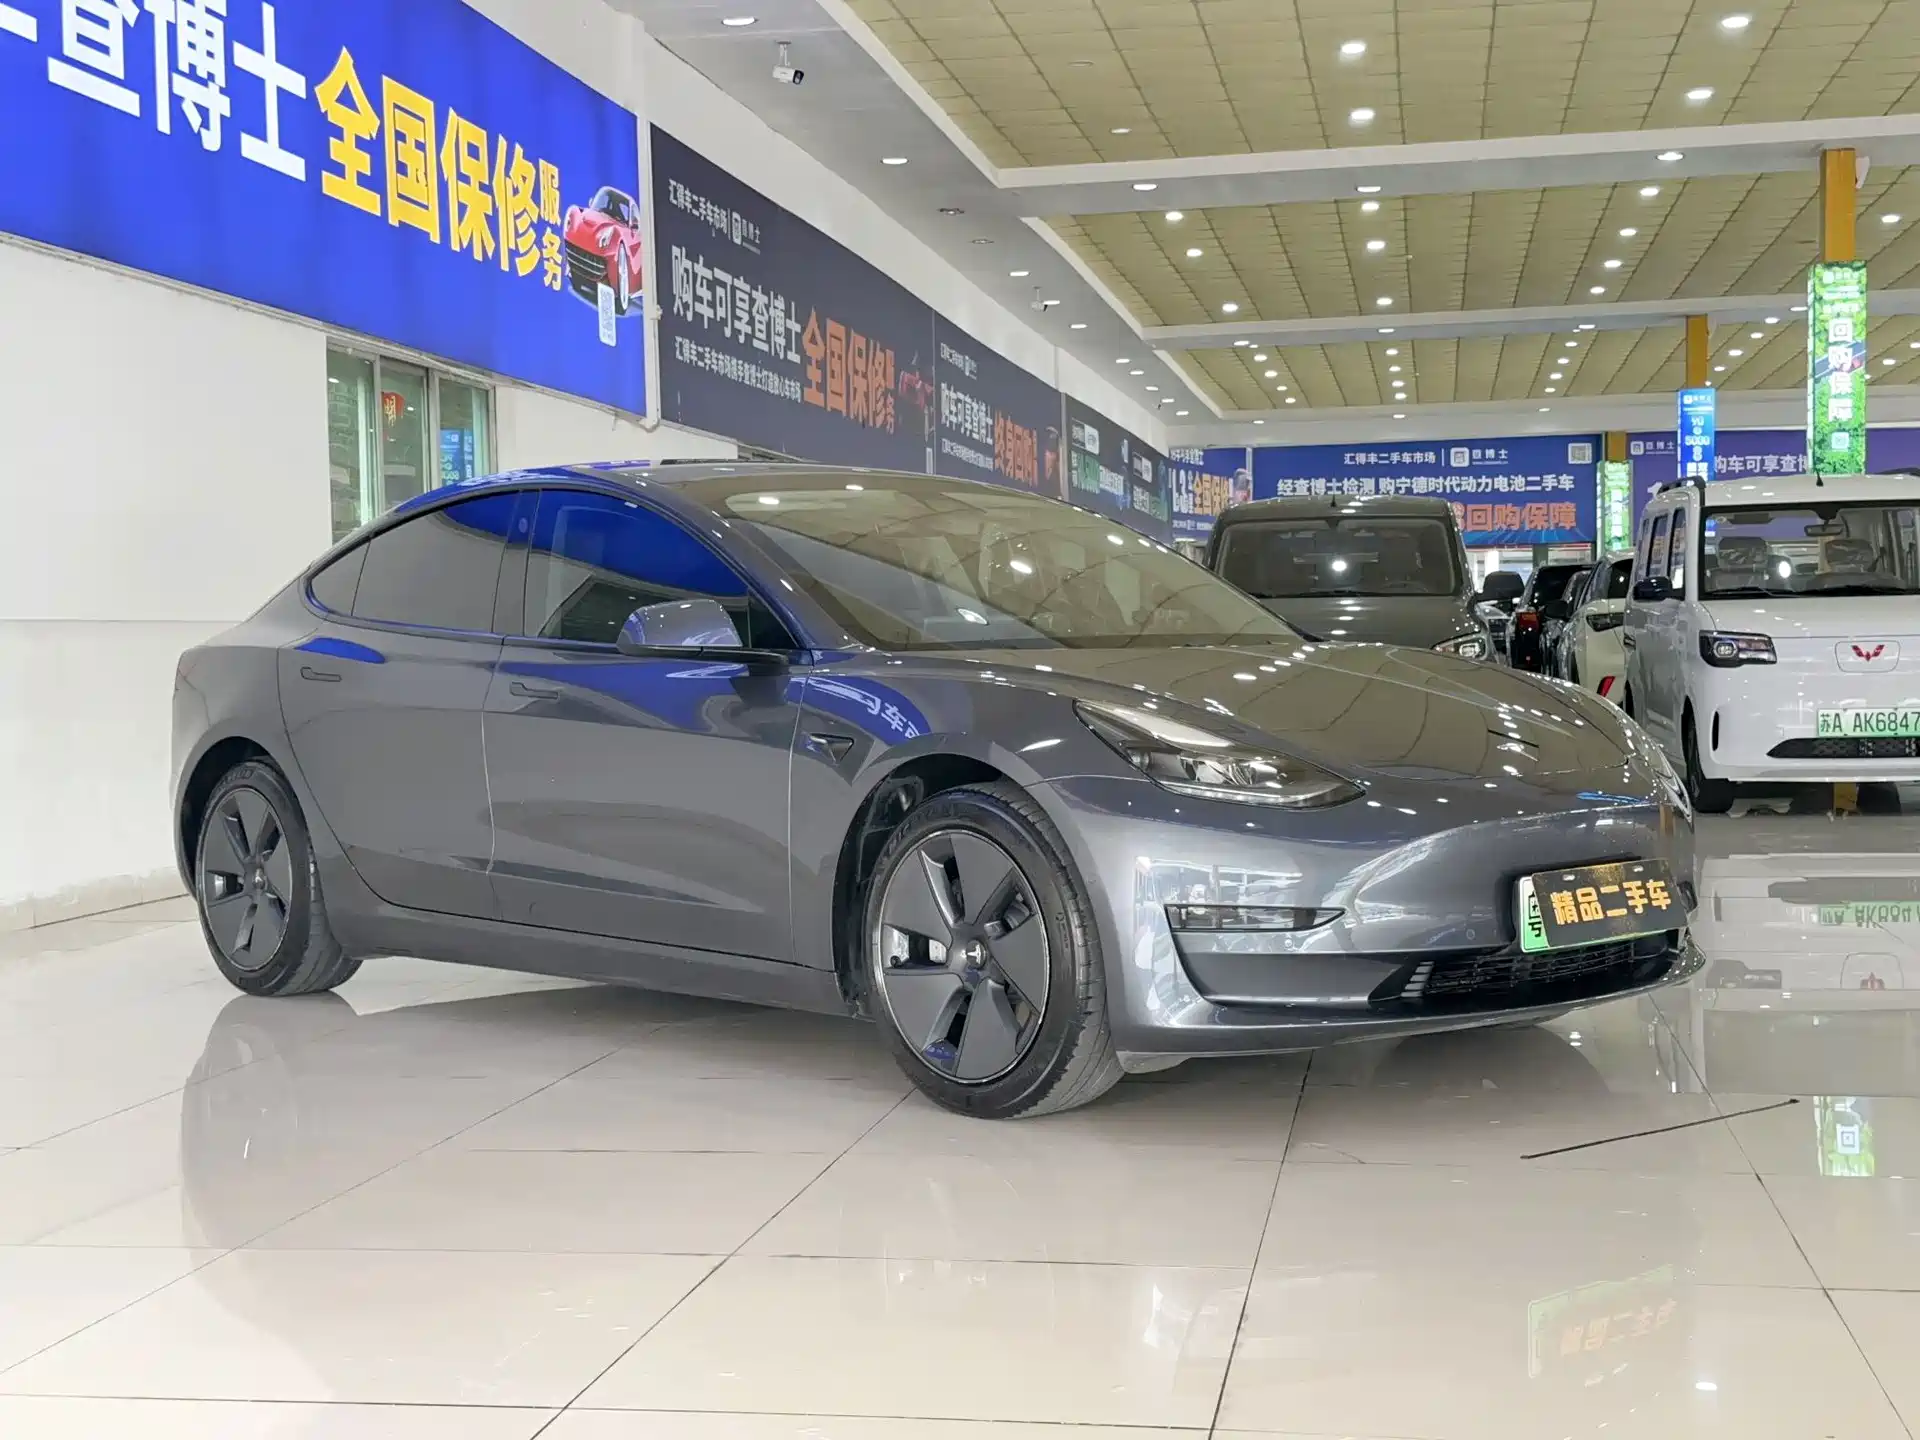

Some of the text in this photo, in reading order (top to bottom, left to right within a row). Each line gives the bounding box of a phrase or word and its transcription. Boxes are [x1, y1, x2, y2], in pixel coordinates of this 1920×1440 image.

[671, 245, 801, 364] 购车可享查博士
[1277, 477, 1375, 496] 经查博士检测
[1820, 712, 1842, 732] 苏A
[1549, 879, 1672, 926] 精品二手车
